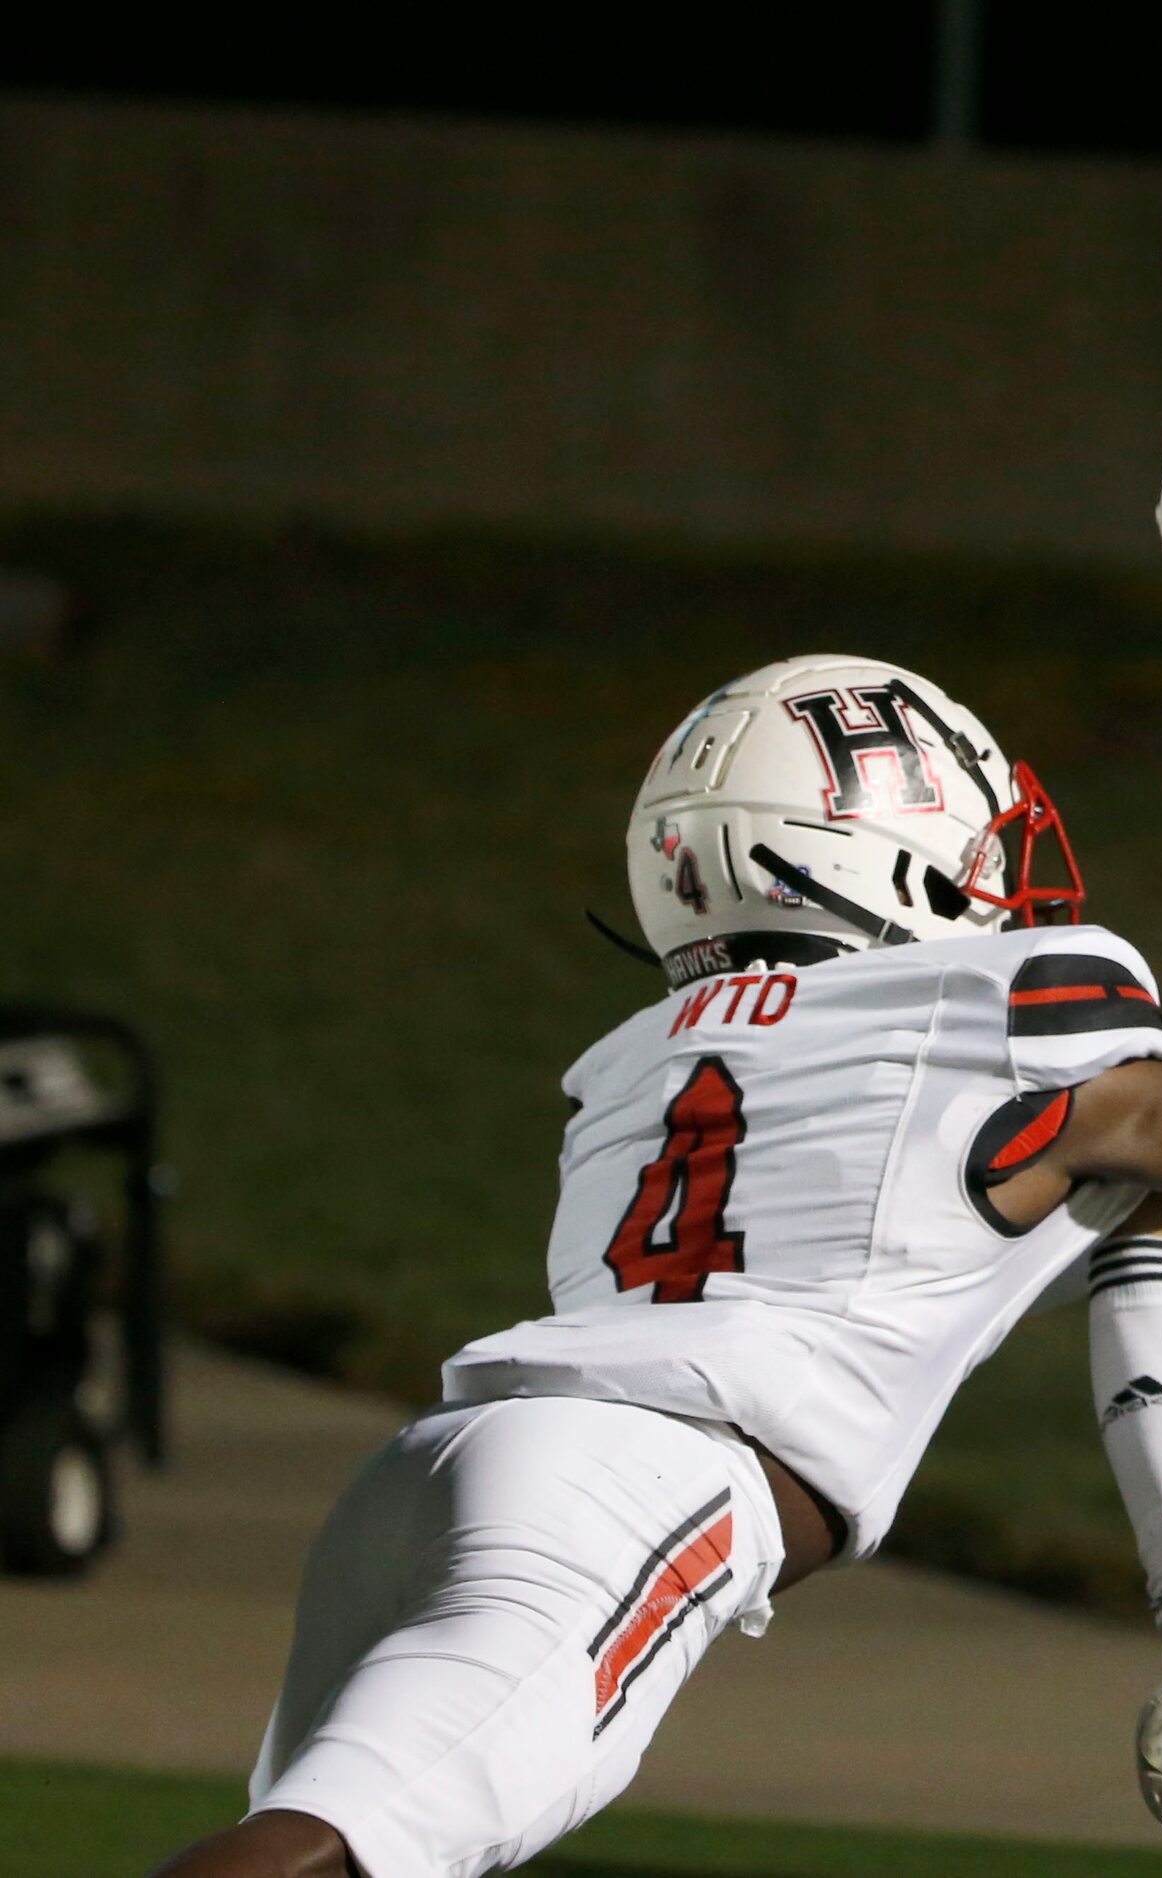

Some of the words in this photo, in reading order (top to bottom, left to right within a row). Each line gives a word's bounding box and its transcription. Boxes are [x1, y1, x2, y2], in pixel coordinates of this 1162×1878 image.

[782, 684, 945, 822] H
[675, 846, 710, 915] 4
[665, 942, 733, 985] HAWKS
[667, 973, 798, 1040] WTD
[603, 1056, 746, 1304] 4
